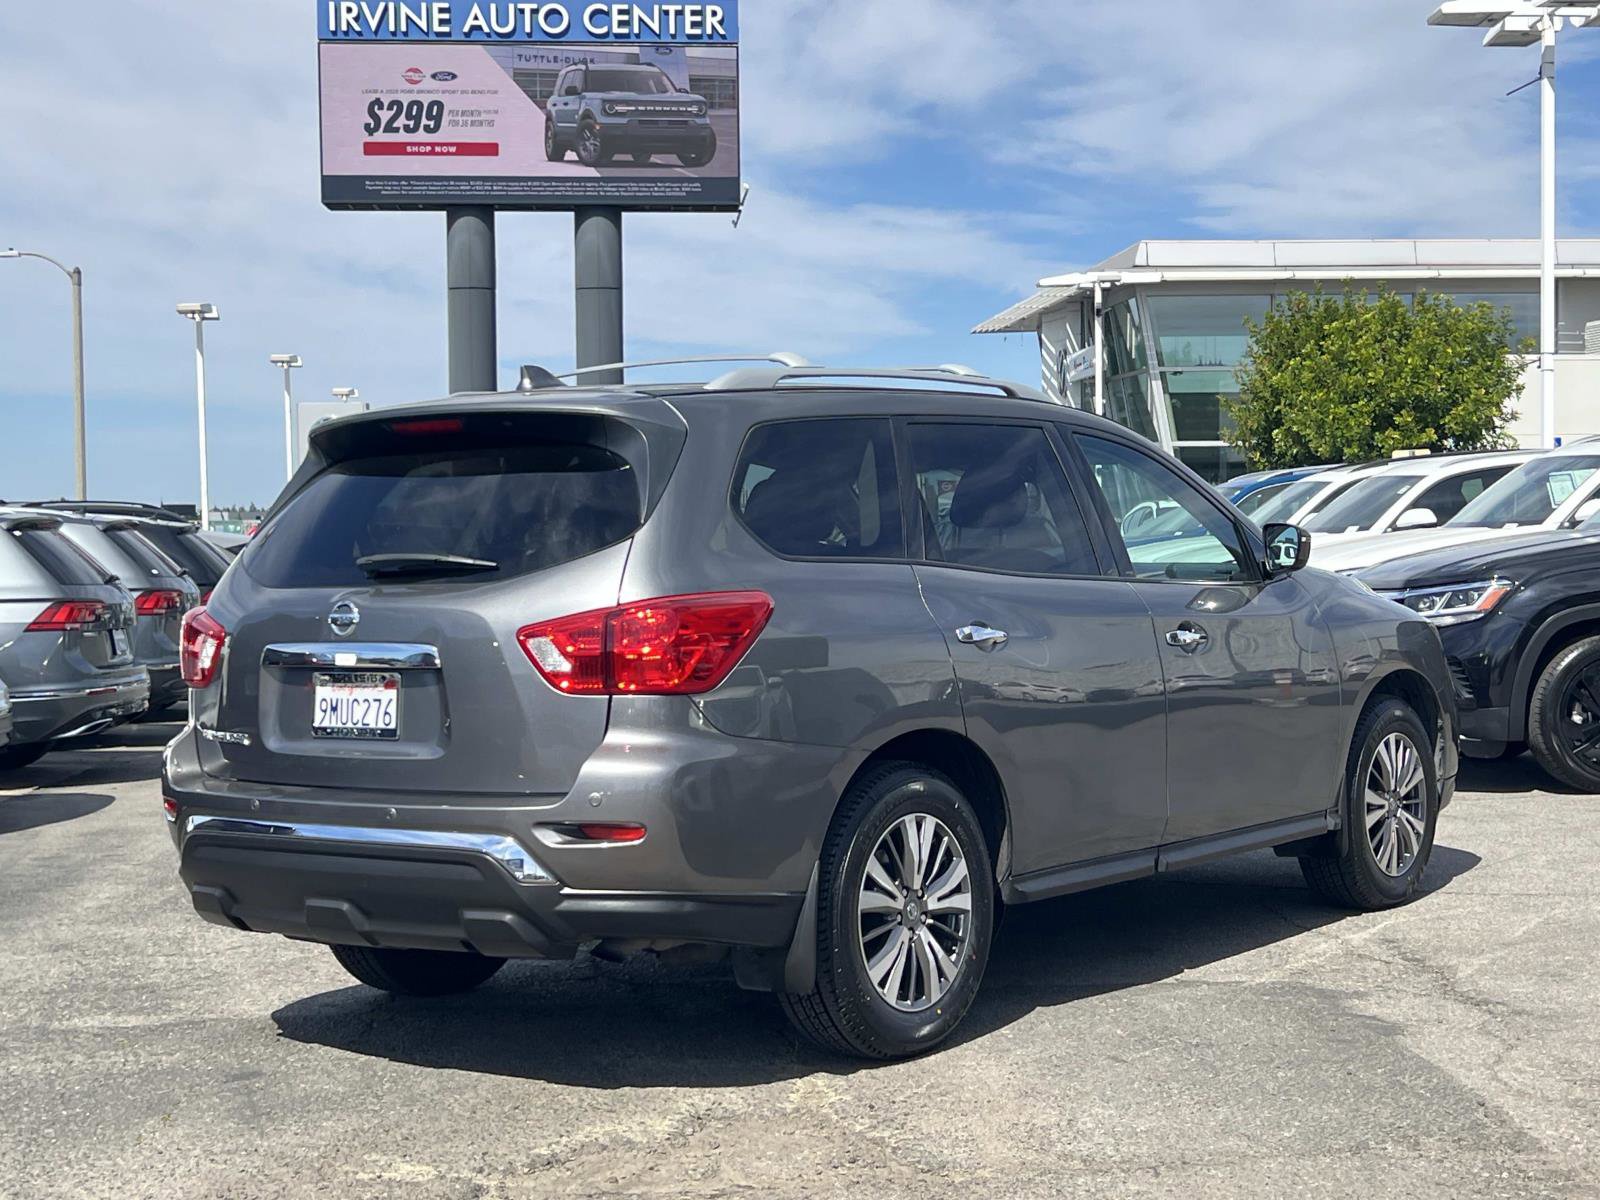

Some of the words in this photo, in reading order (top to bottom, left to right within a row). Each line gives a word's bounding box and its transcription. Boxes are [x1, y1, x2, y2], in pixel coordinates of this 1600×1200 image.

[328, 0, 451, 36] IRVINE
[462, 2, 570, 36] AUTO
[582, 2, 728, 37] CENTER
[364, 97, 445, 137] $299
[460, 109, 482, 118] MONTH
[470, 119, 495, 128] MONTHS
[406, 145, 432, 153] SHOP
[434, 145, 457, 153] NOW
[320, 698, 393, 727] 9MUC276
